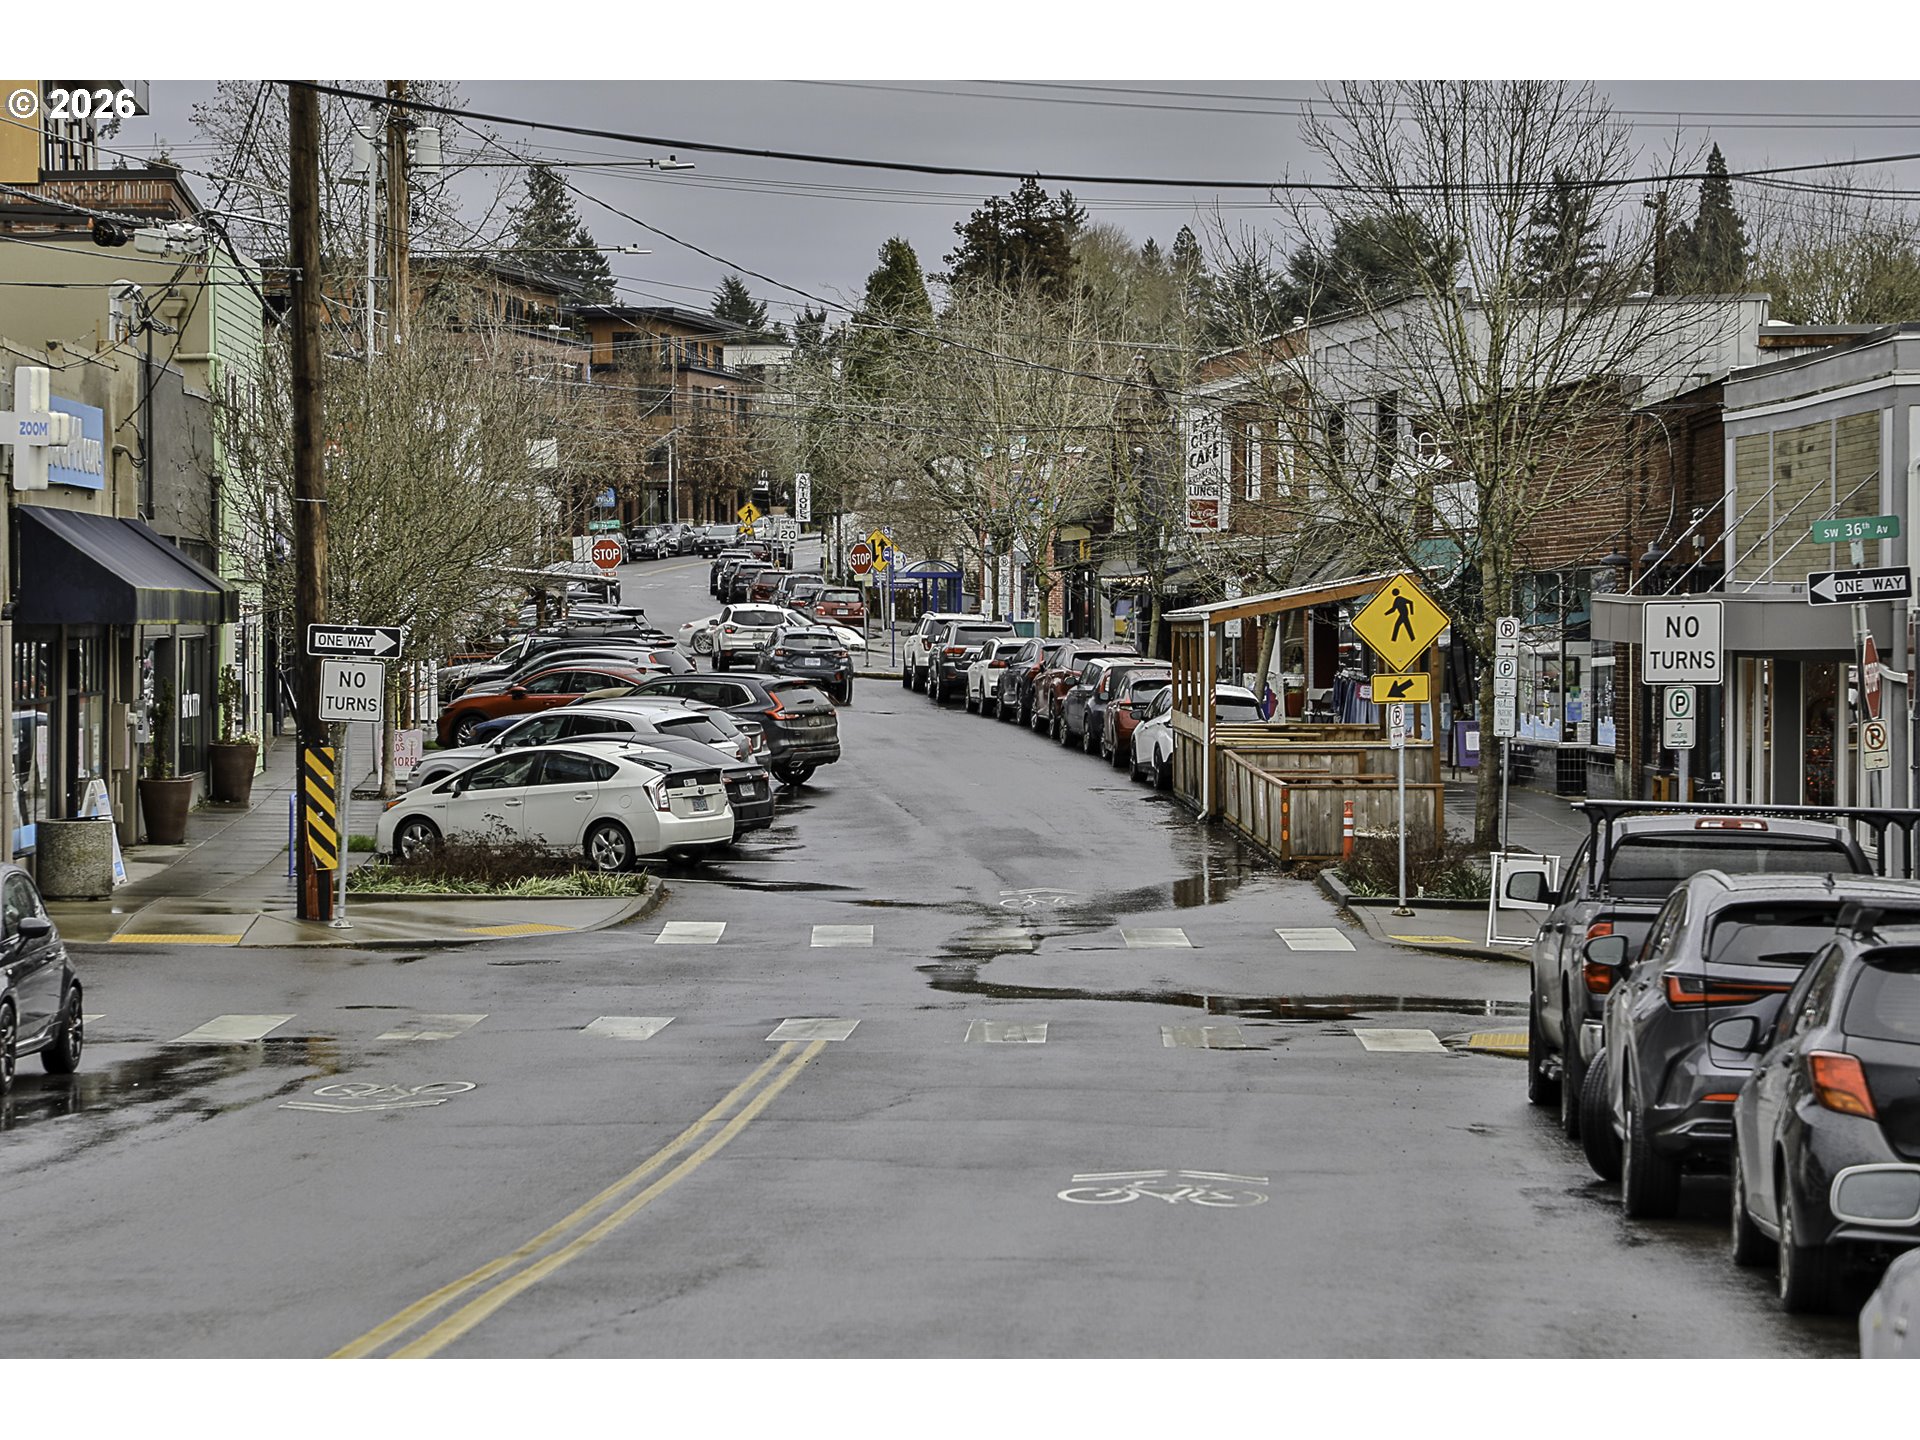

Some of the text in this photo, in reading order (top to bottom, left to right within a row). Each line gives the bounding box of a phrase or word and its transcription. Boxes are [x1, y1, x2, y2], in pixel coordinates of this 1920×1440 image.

[19, 421, 48, 436] ZOOM
[1191, 425, 1218, 449] CITY
[1189, 441, 1220, 469] CAFE
[1189, 486, 1219, 497] LUNCH
[780, 530, 796, 539] 20
[1824, 522, 1888, 538] SW 36th Av
[593, 548, 620, 561] STOP
[851, 552, 871, 566] STOP
[1834, 576, 1903, 593] ONE WAY
[1666, 615, 1700, 638] NO
[318, 634, 374, 648] ONE WAY
[1650, 650, 1716, 669] TURNS
[339, 670, 367, 689] NO
[325, 696, 378, 713] TURNS
[1676, 722, 1682, 732] 2
